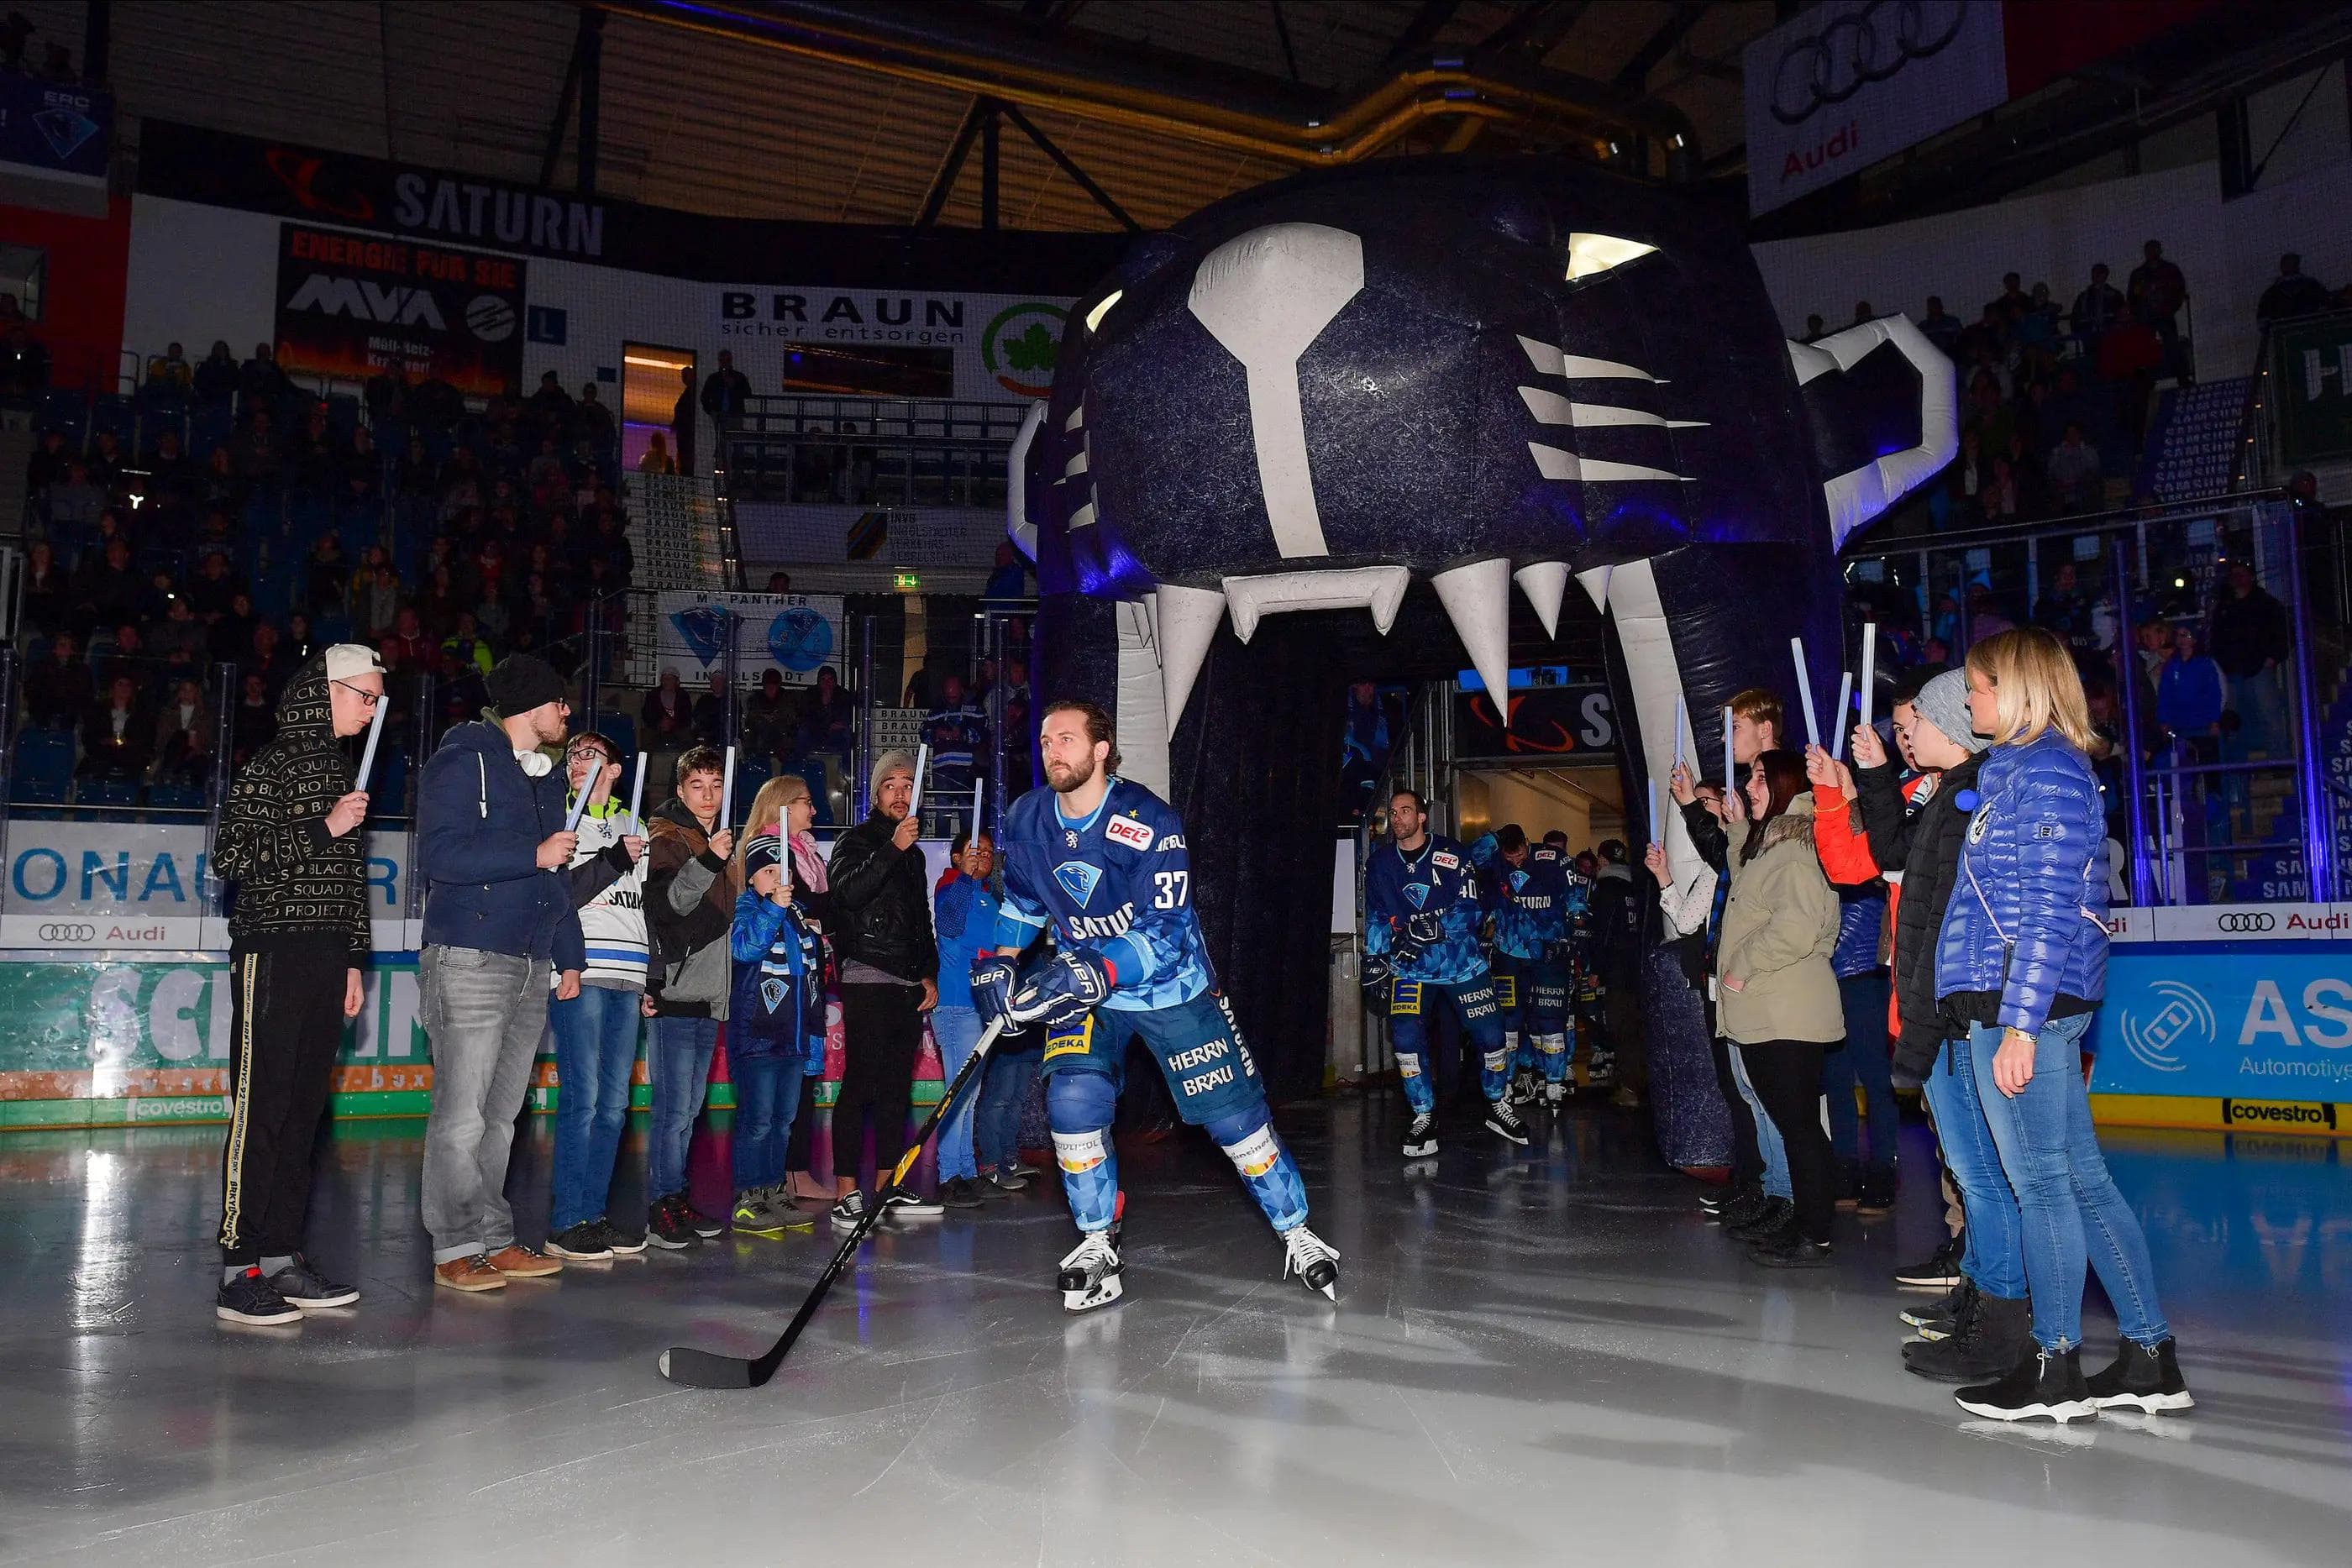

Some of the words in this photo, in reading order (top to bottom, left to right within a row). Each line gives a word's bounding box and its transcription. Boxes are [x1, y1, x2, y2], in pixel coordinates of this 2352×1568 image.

[45, 91, 90, 108] ERC
[1780, 121, 1857, 183] Audi
[393, 171, 605, 256] SATURN
[286, 273, 448, 332] MVA
[722, 291, 964, 328] BRAUN
[722, 321, 805, 337] sicher
[825, 327, 963, 344] entsorgen
[647, 539, 688, 548] BRAUN
[647, 549, 689, 559] BRAUN
[647, 559, 690, 569] BRAUN
[648, 570, 690, 579] BRAUN
[648, 581, 691, 590] BRAUN
[697, 595, 708, 604] M
[730, 595, 807, 606] PANTHER
[881, 711, 927, 719] BRAUN
[882, 723, 920, 732] BRAU
[881, 735, 917, 743] BRAU
[1431, 868, 1442, 886] A
[294, 884, 344, 897] SQUAD
[1154, 870, 1189, 909] 37
[1458, 878, 1478, 899] 40
[2286, 913, 2349, 929] Audi
[106, 926, 165, 941] Audi
[1458, 986, 1494, 1004] HERRN
[1536, 986, 1565, 996] HERRN
[1467, 1002, 1497, 1019] BRÄU
[1046, 1039, 1084, 1053] EDEKA
[1168, 1037, 1229, 1072] HERRN
[1183, 1065, 1234, 1097] BRÄU
[136, 1097, 223, 1117] covestro
[2232, 1104, 2323, 1123] covestro
